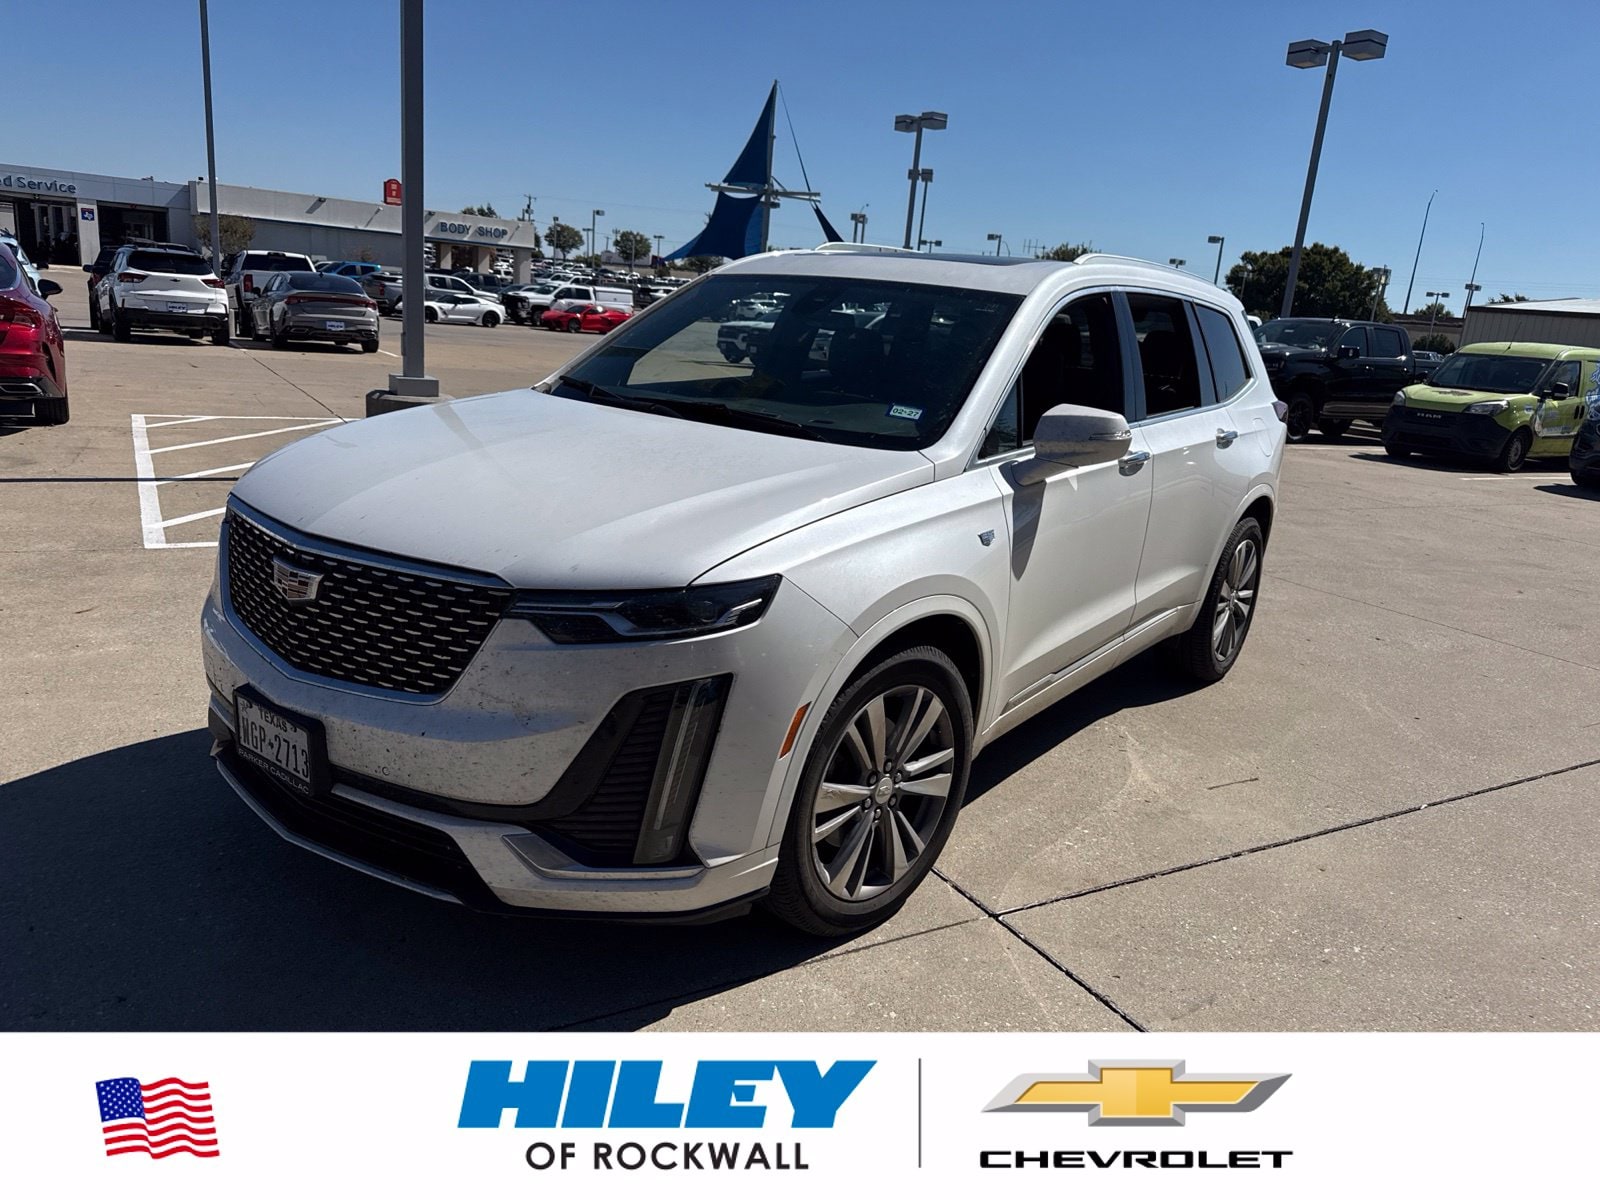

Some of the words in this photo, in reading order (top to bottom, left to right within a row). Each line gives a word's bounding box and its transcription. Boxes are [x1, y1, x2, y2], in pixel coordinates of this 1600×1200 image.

[16, 176, 76, 193] Service
[440, 222, 471, 235] BODY
[478, 226, 508, 239] SHOP
[259, 708, 287, 732] TEXAS
[271, 764, 309, 795] CADILLAC
